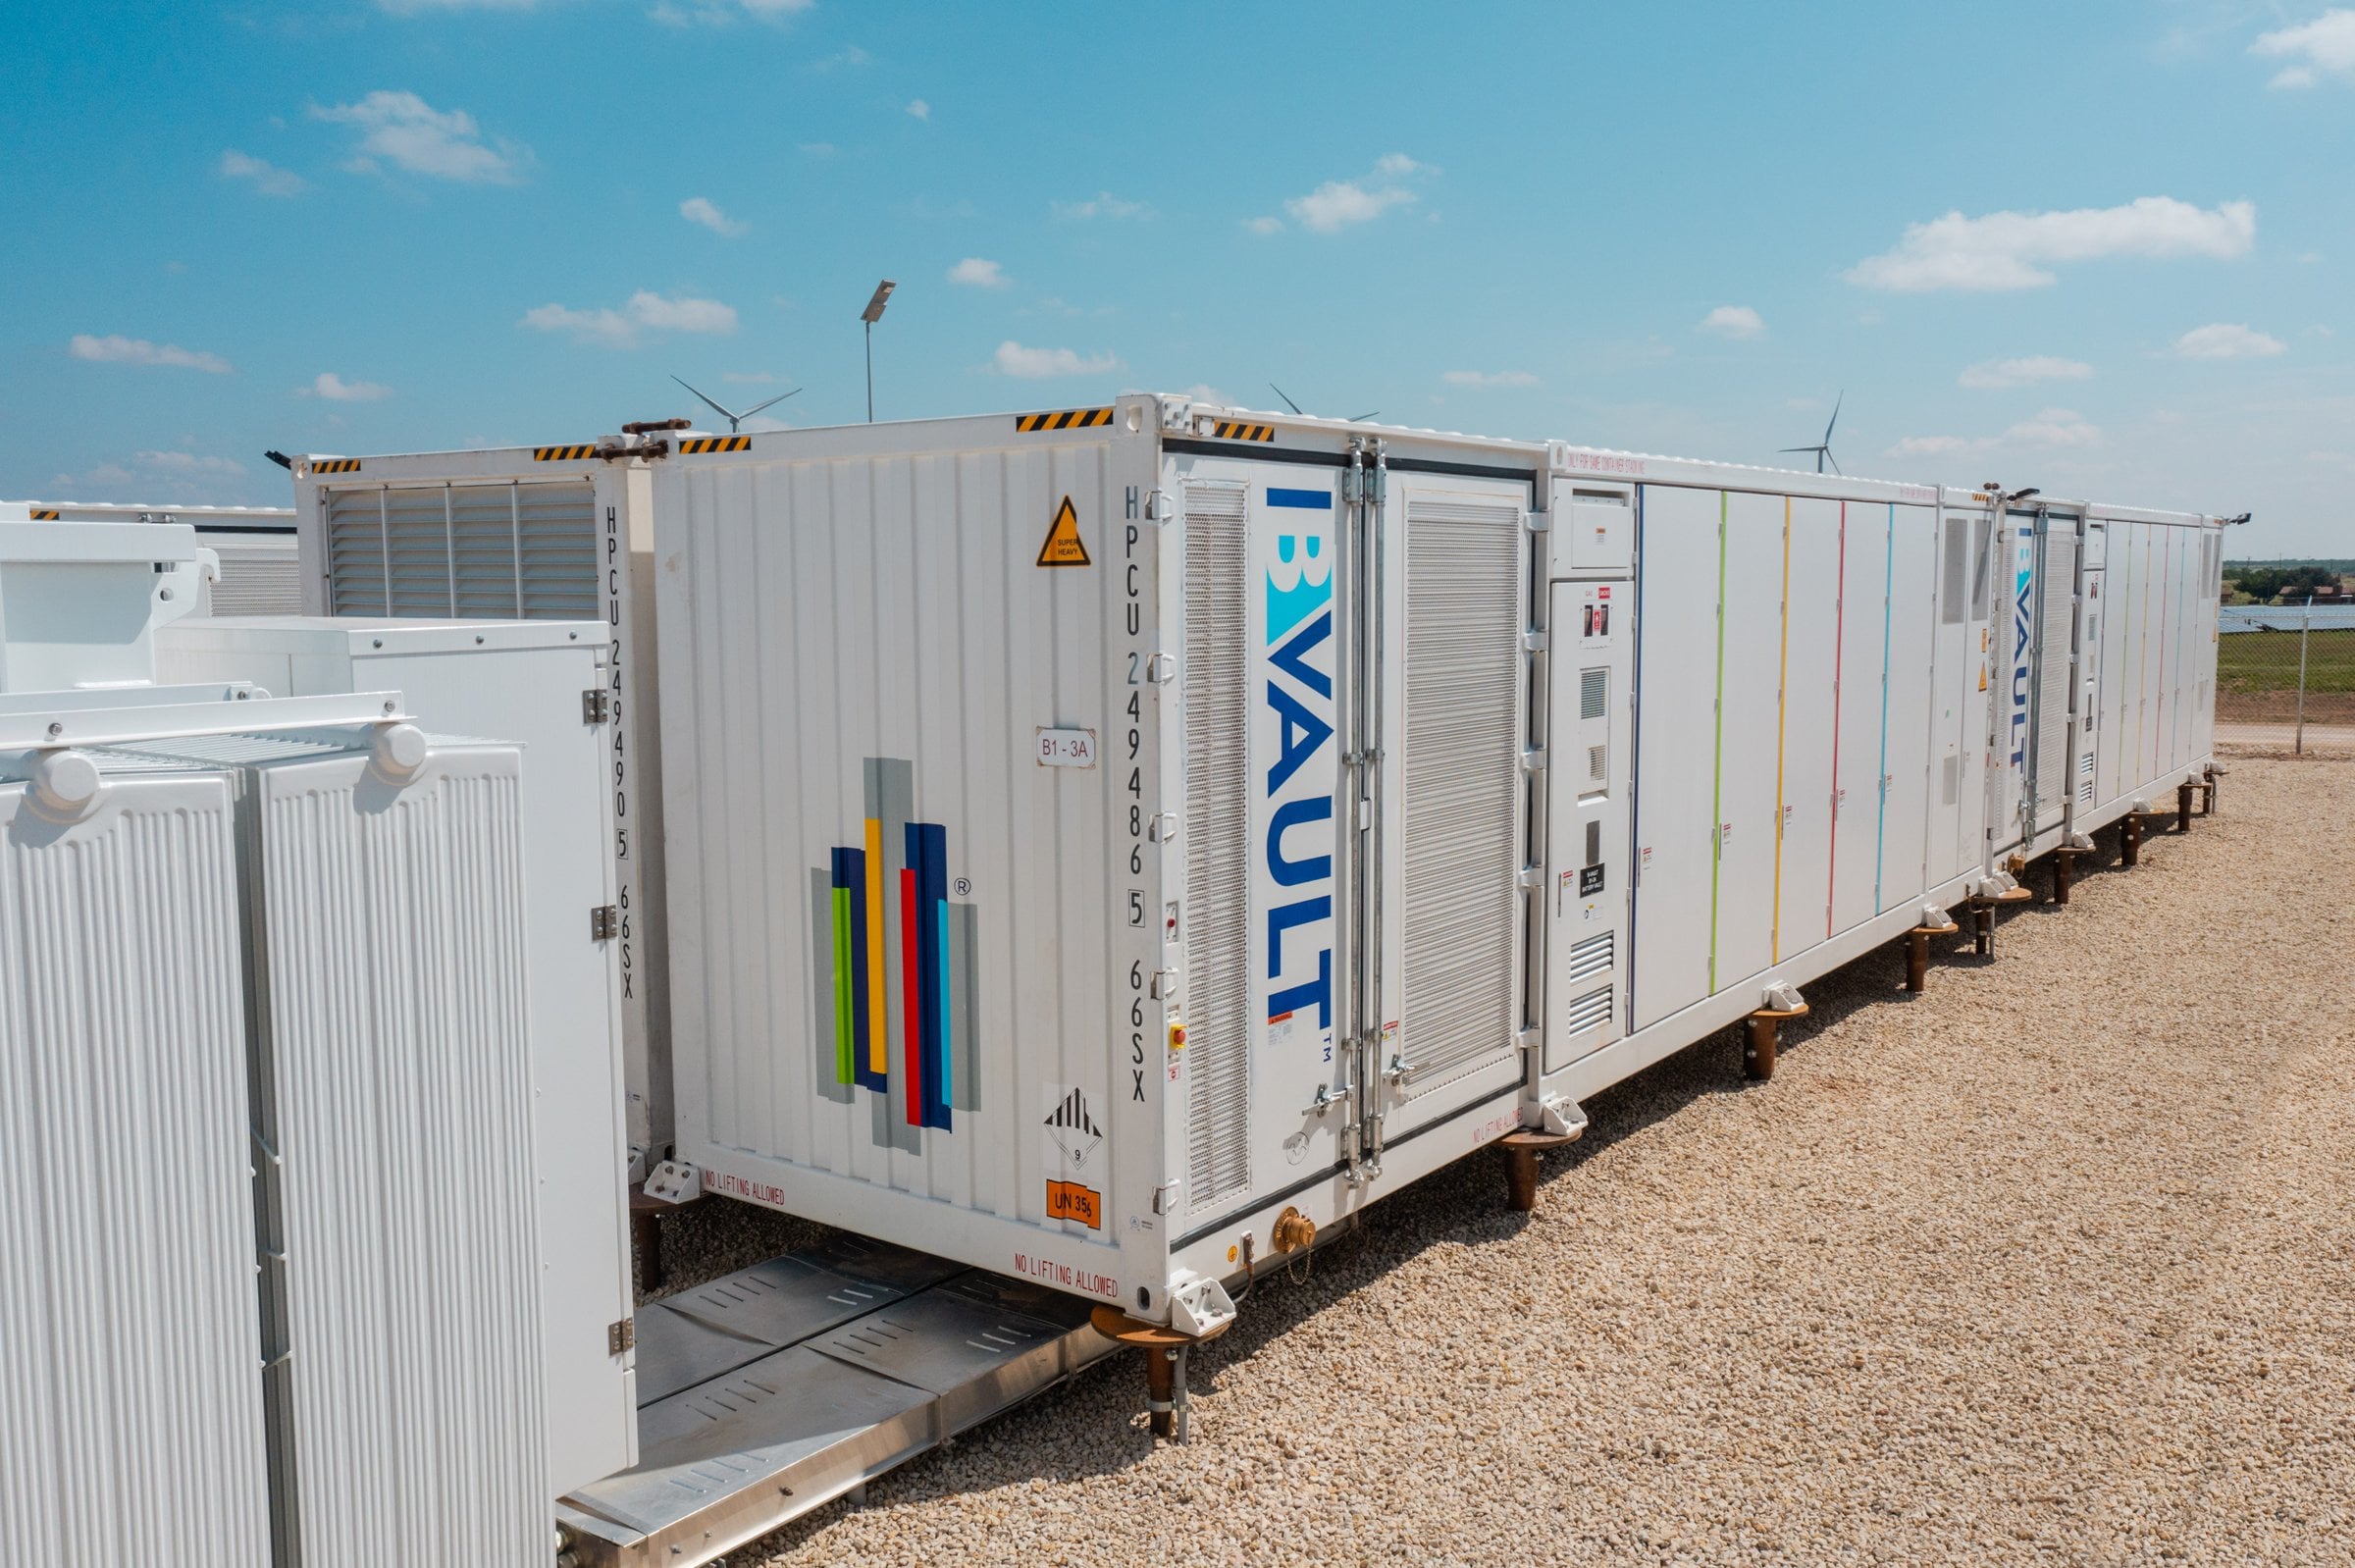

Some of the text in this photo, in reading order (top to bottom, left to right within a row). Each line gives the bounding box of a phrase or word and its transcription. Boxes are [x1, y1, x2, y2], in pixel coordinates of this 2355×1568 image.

[606, 506, 633, 999] HPCU 249490 5 66SX
[1042, 738, 1057, 756] B1
[1071, 740, 1088, 758] 3A
[1125, 486, 1145, 1102] HPCU 249486 5 66SX
[1074, 1149, 1081, 1160] 9
[706, 1170, 785, 1205] NO LIFTING ALLOWED
[1055, 1193, 1072, 1210] UN
[1015, 1253, 1119, 1298] NO LIFTING ALLOWED
